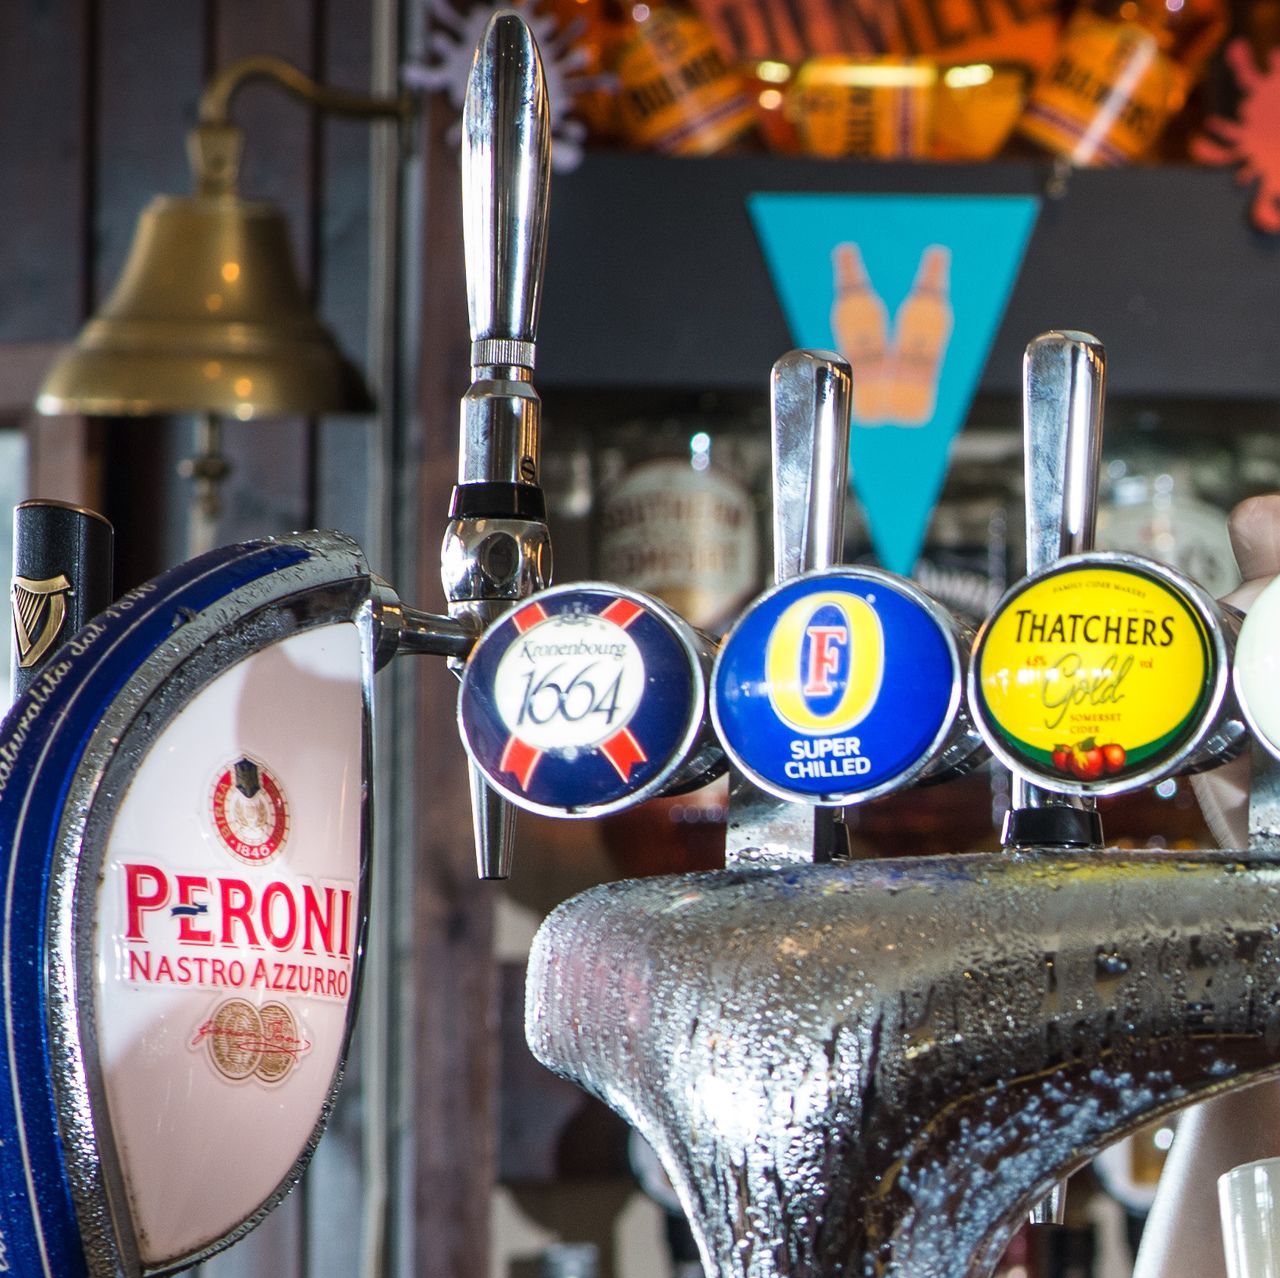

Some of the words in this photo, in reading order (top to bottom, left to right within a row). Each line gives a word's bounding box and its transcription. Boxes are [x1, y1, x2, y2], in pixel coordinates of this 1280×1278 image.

[1015, 609, 1175, 648] THATCHERS
[518, 639, 627, 664] Kronenbourg
[516, 660, 626, 727] 1664
[1041, 652, 1135, 730] Gold
[789, 736, 861, 760] SUPER
[784, 757, 872, 779] CHILLED
[235, 844, 271, 858] 1846
[124, 863, 353, 960] PERONI
[128, 950, 246, 989] NASTRO
[249, 957, 349, 998] AZZURRO
